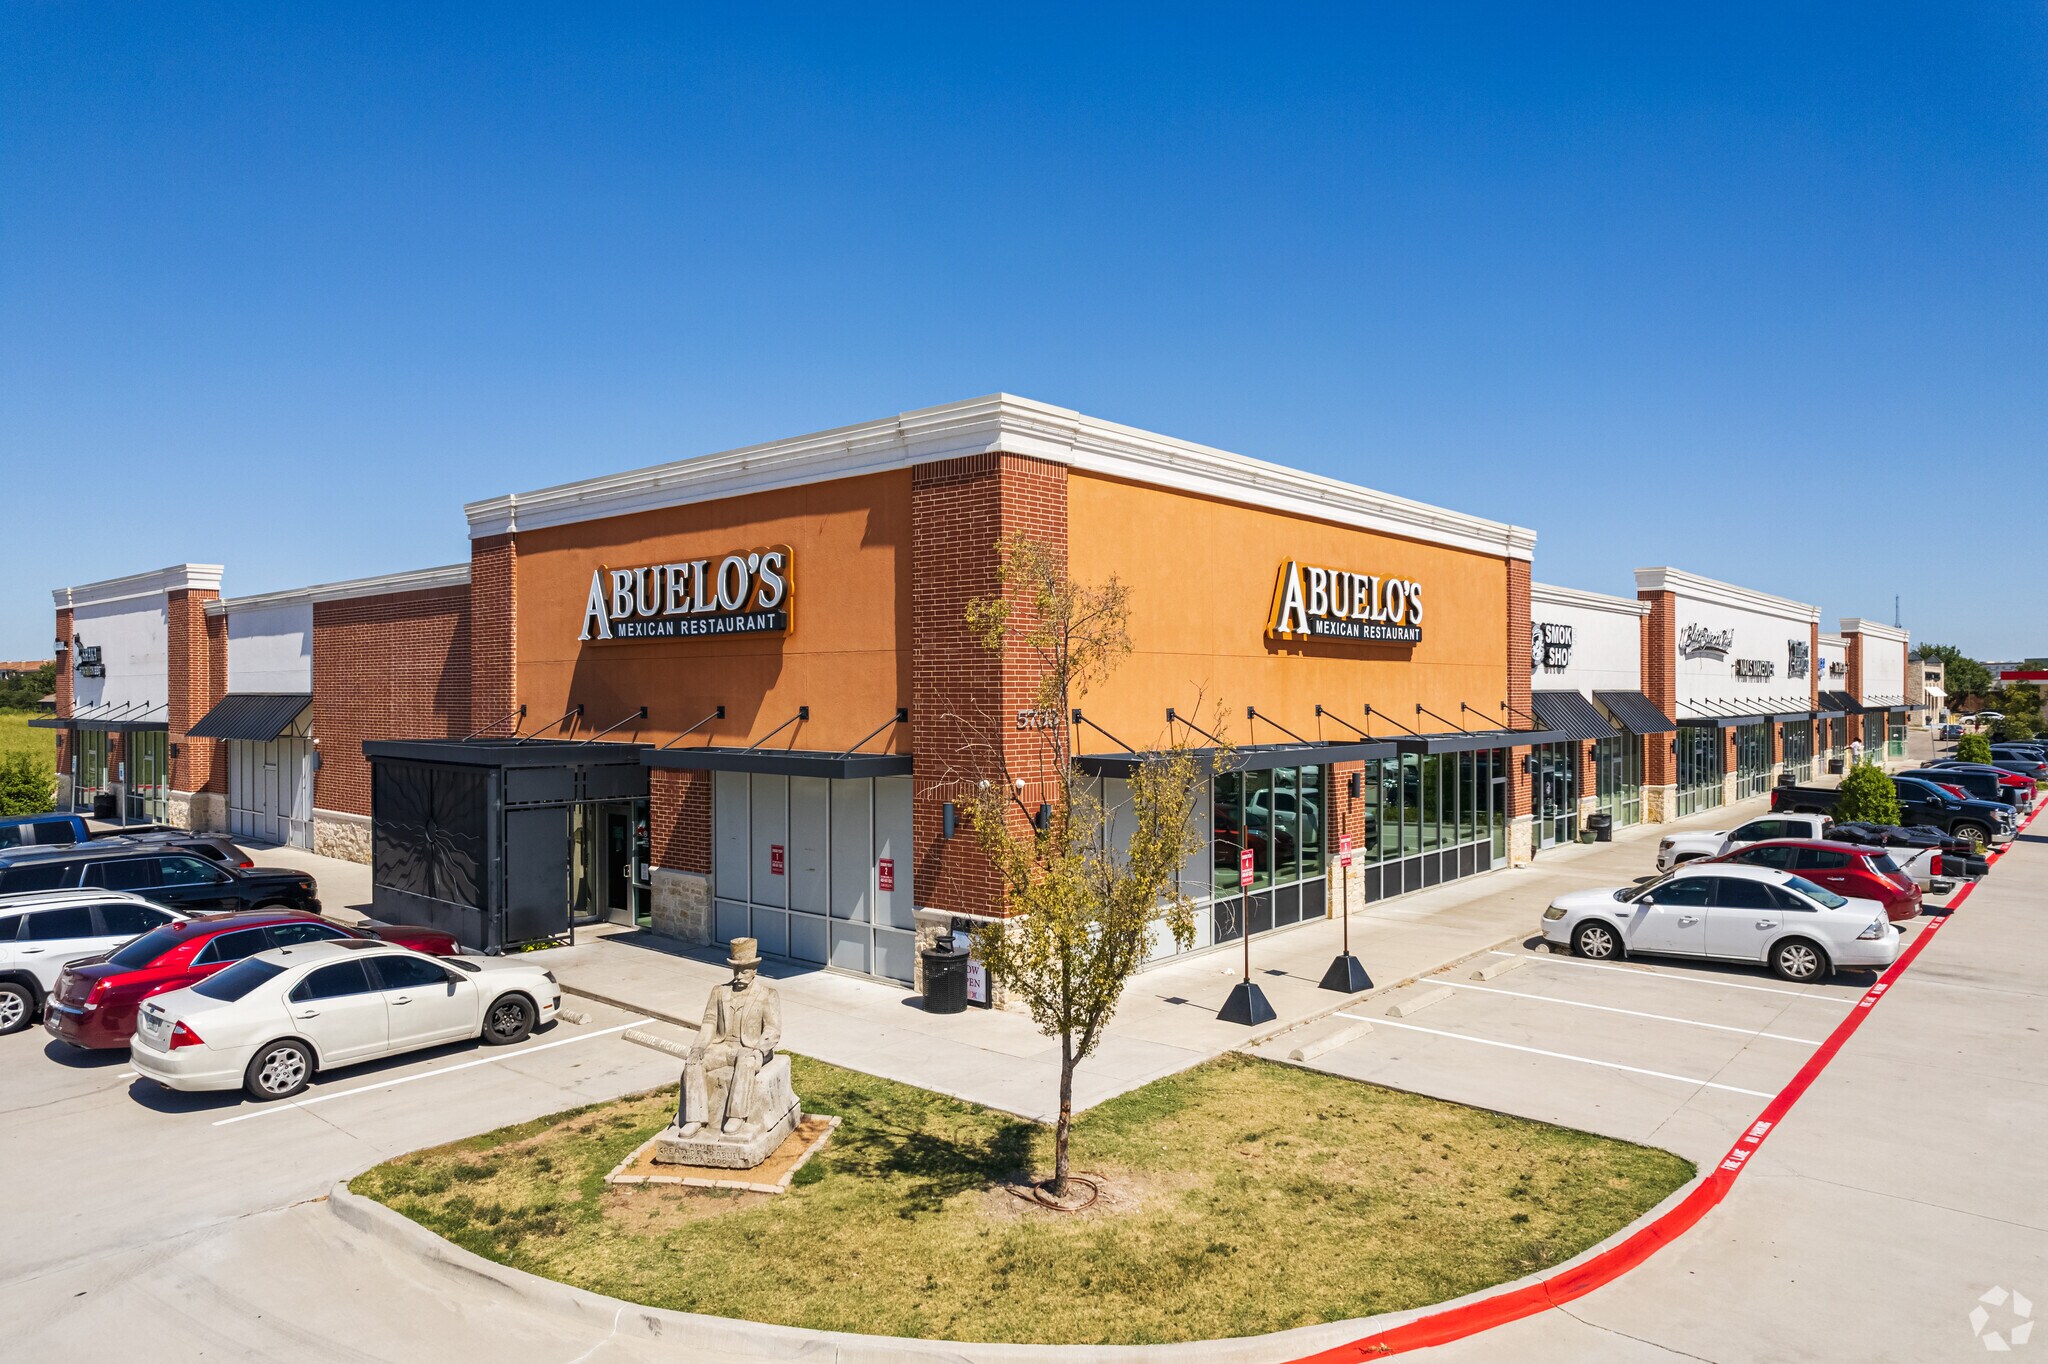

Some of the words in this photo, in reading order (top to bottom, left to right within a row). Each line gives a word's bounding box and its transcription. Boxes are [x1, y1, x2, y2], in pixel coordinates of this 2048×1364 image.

[578, 552, 783, 641] ABUELO'S
[1278, 561, 1423, 635] ABUELO'S
[618, 621, 674, 637] MEXICAN
[681, 613, 777, 635] RESTAURANT
[1316, 620, 1360, 637] MEXICAN
[1363, 625, 1420, 641] RESTAURANT
[966, 965, 980, 975] OW
